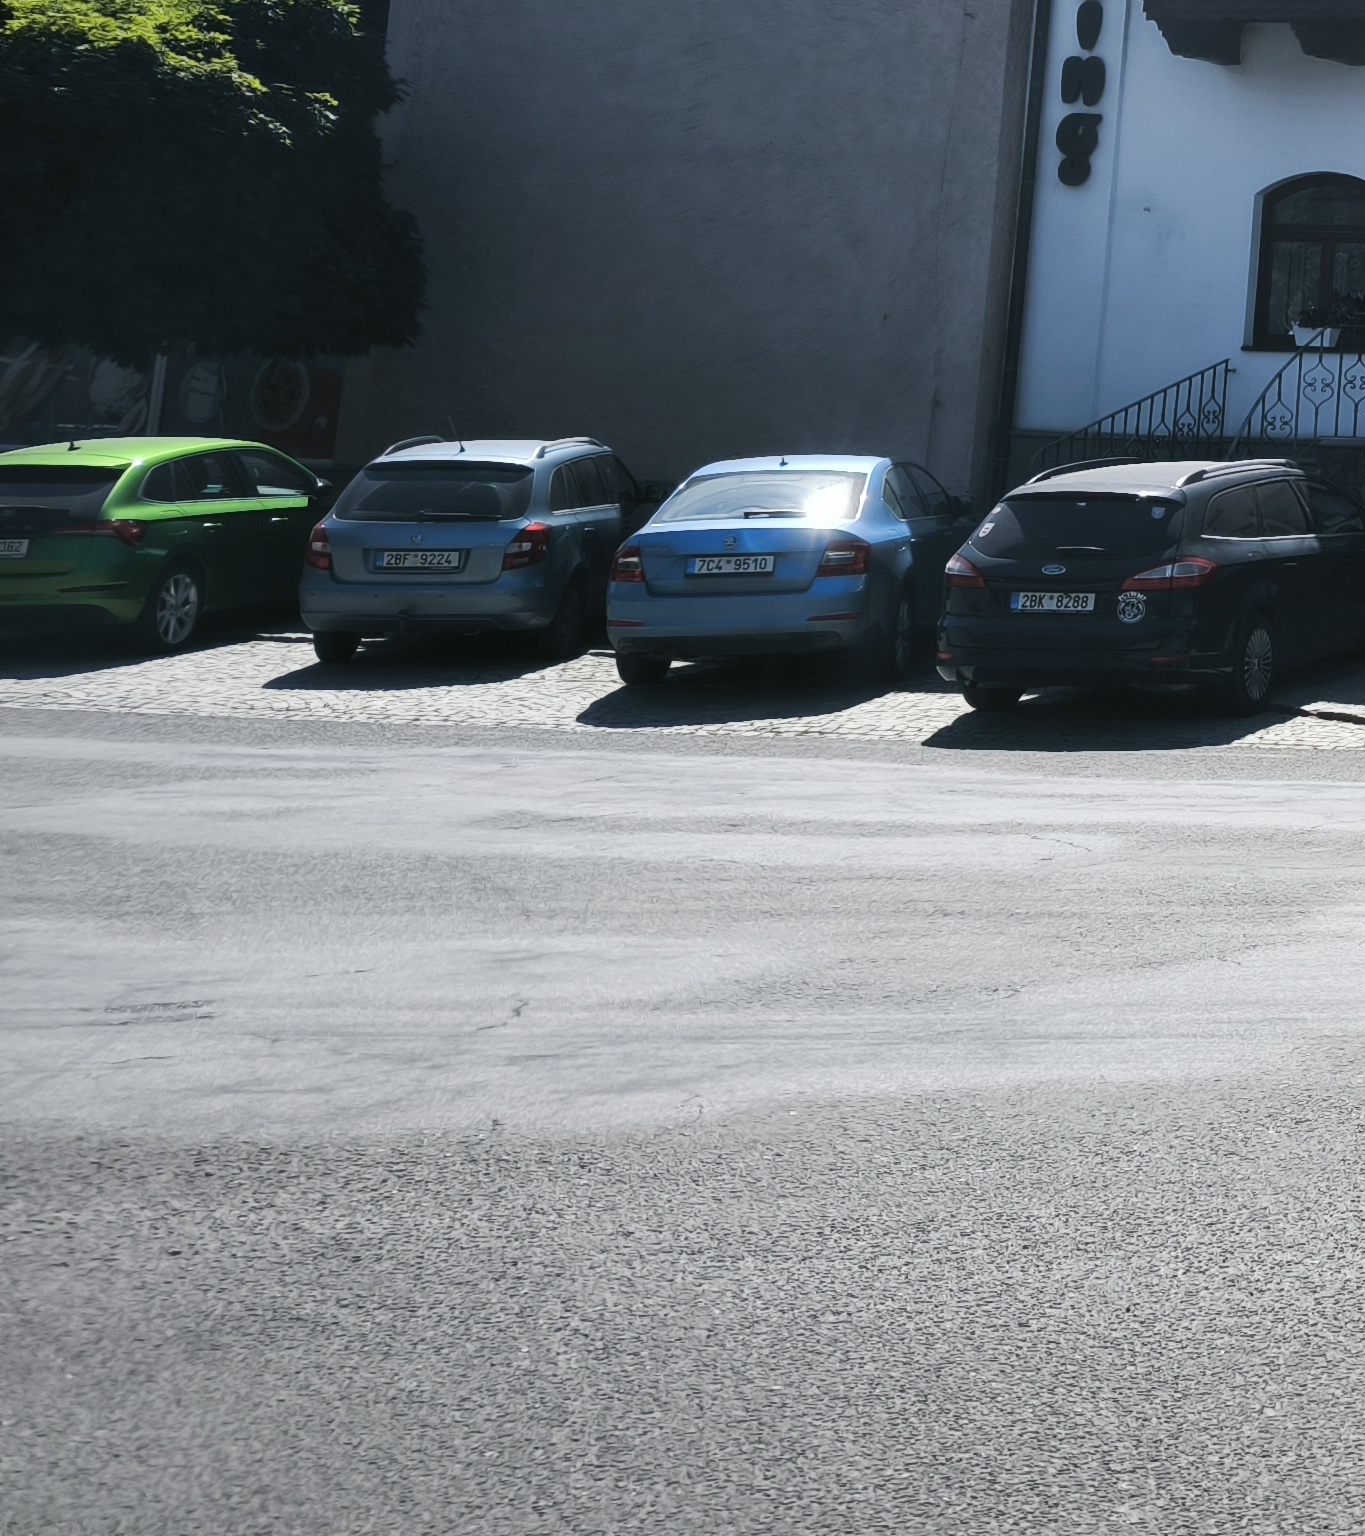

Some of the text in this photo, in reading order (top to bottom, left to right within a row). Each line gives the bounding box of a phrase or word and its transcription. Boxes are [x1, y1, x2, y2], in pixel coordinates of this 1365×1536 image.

[385, 553, 453, 566] 2BF 9224
[696, 559, 723, 572] 7C4
[733, 557, 768, 571] 9510
[1020, 594, 1090, 610] 2BK 8288
